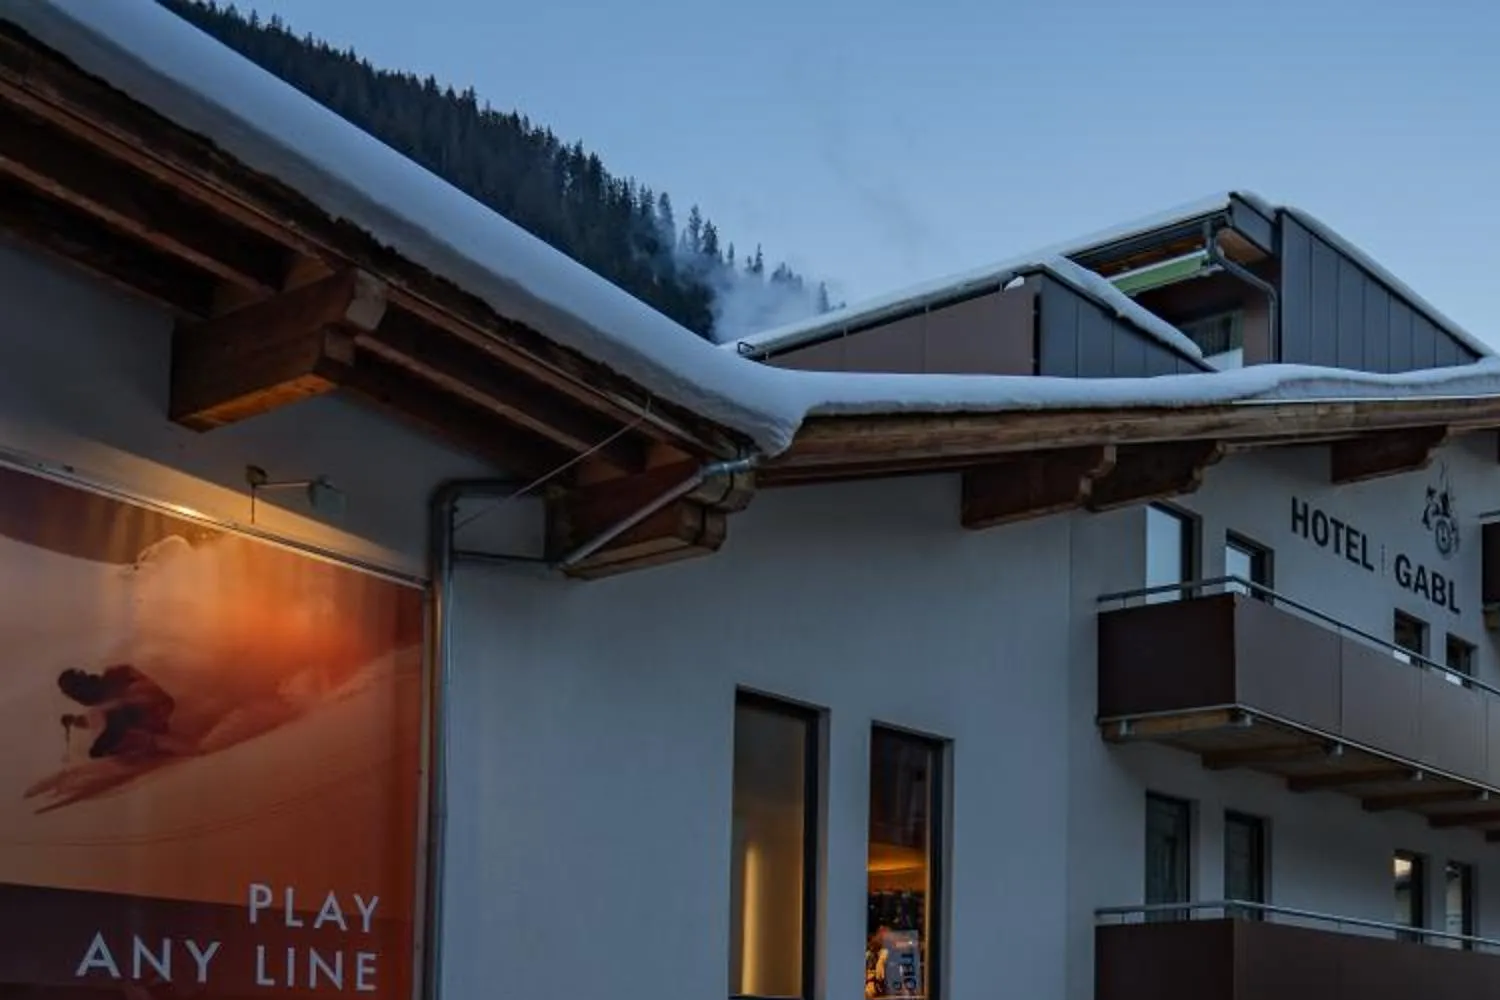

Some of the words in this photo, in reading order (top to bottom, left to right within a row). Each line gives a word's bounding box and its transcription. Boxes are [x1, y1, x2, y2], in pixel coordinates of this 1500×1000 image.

[1291, 496, 1374, 572] HOTEL
[1394, 554, 1461, 614] GABL
[248, 883, 380, 933] PLAY
[75, 931, 222, 984] ANY
[256, 945, 378, 991] LINE
